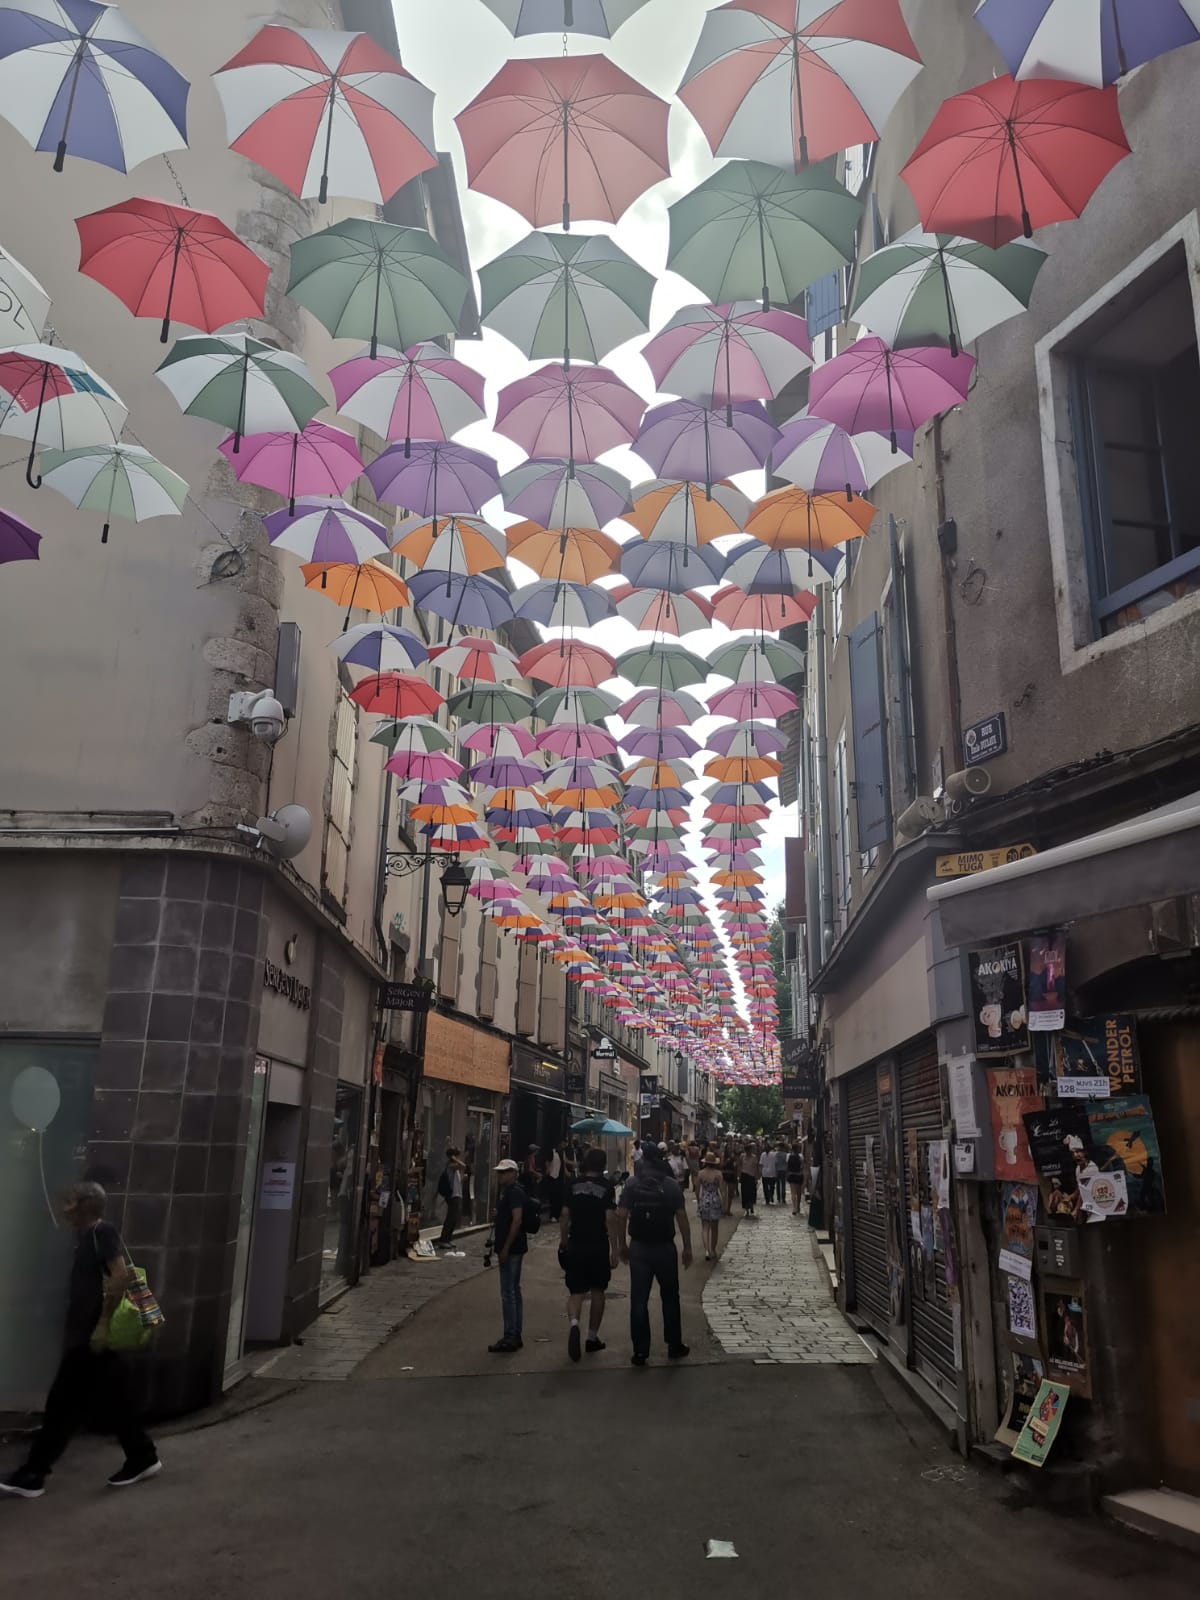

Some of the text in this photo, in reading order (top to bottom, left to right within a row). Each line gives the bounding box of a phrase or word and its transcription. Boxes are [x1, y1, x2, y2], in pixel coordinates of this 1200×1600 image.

[981, 724, 993, 737] RUE
[957, 853, 984, 864] MIMO
[958, 862, 983, 872] TUGA
[1105, 1019, 1122, 1092] WONDER
[1119, 1025, 1135, 1083] PETROL
[1060, 1084, 1075, 1093] 128
